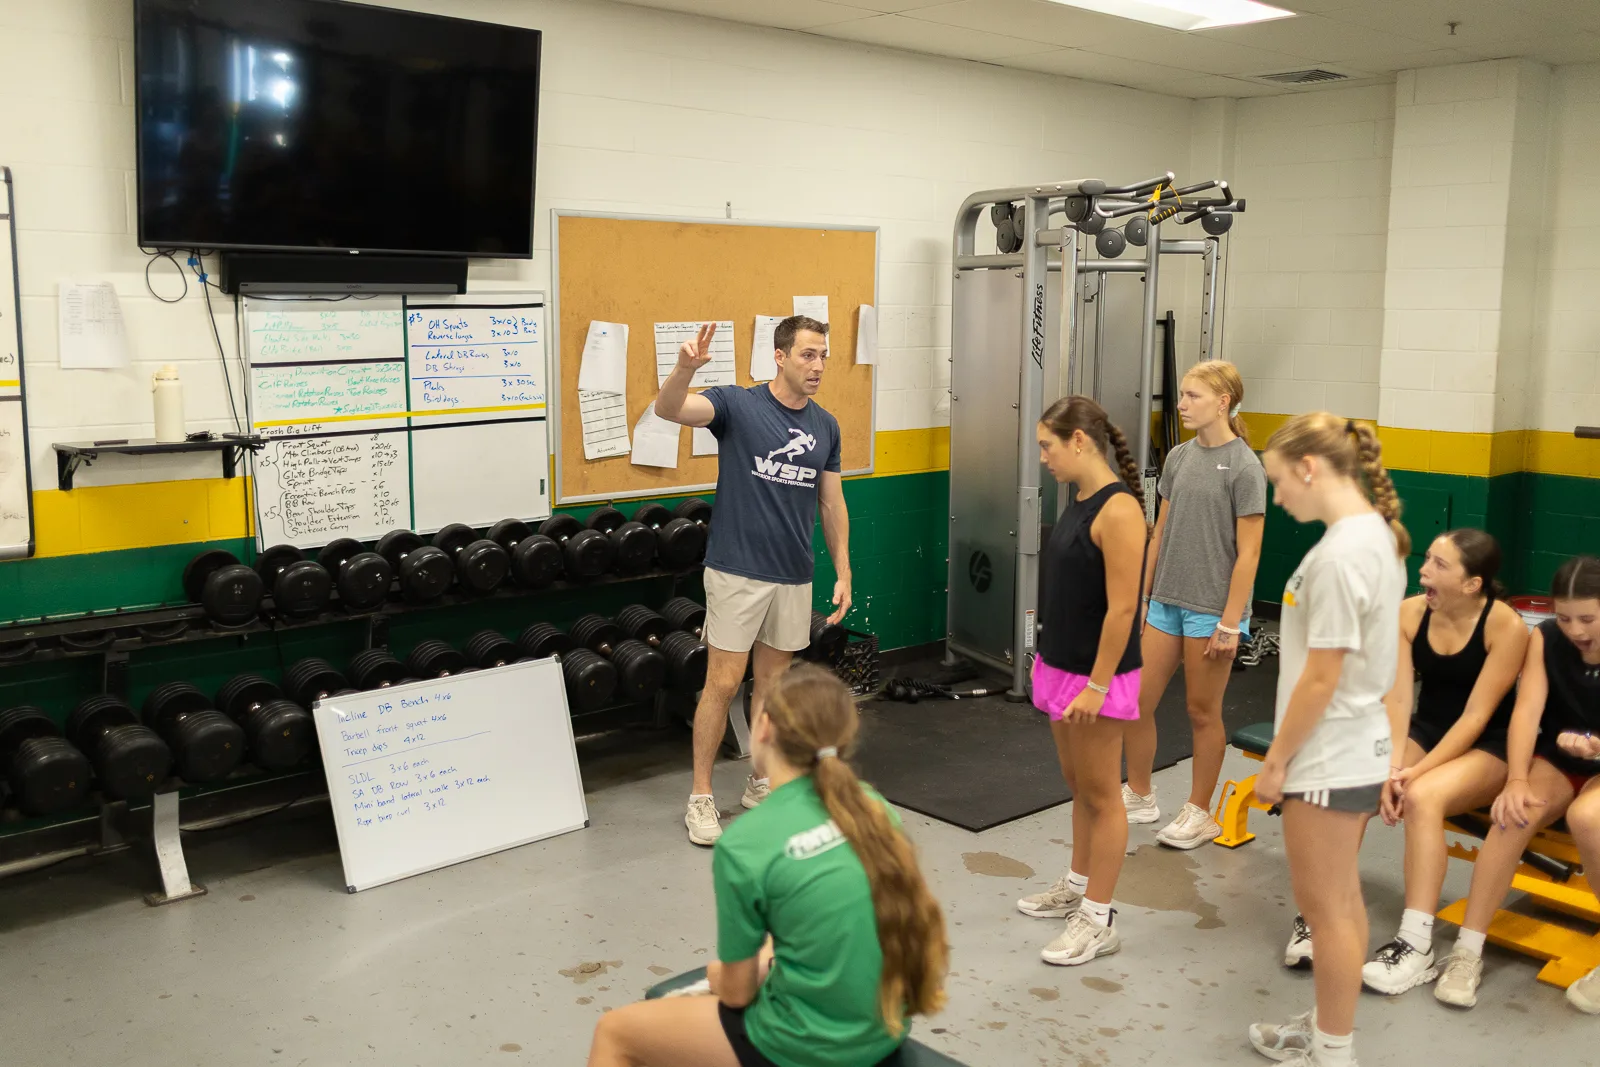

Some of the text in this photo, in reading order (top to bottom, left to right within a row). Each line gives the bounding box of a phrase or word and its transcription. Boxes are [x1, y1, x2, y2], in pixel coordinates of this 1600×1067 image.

[428, 331, 453, 341] Reverse
[425, 349, 455, 360] Lateral
[425, 363, 438, 372] DB
[284, 380, 308, 388] Raises
[259, 426, 284, 436] Frosh
[303, 424, 322, 433] Lift
[282, 442, 305, 450] Front
[306, 439, 331, 449] Squat
[300, 447, 332, 457] Climbers
[260, 456, 271, 468] x5
[283, 460, 302, 470] High
[283, 469, 306, 480] Glute
[308, 467, 332, 479] Bridge
[754, 455, 818, 482] WSP
[286, 479, 316, 490] Sprint
[284, 490, 317, 501] Eccentric
[319, 488, 341, 497] Bench
[341, 485, 357, 495] Press
[264, 506, 277, 519] x5
[308, 504, 339, 515] Shoulder
[287, 518, 324, 528] Shoulder
[328, 514, 361, 524] Extension
[291, 526, 327, 537] Suitcase
[337, 711, 368, 723] Incline
[378, 702, 393, 715] DB
[400, 696, 429, 709] Bench
[341, 729, 370, 742] Barbell
[376, 724, 398, 735] front
[405, 717, 428, 730] squat
[344, 746, 368, 757] Tricep
[372, 741, 388, 754] dips
[348, 772, 375, 785] SLDL
[412, 758, 430, 769] each
[352, 788, 365, 800] SA
[371, 784, 384, 795] DB
[439, 766, 457, 777] each
[354, 800, 374, 812] Mini
[377, 796, 395, 807] band
[401, 789, 423, 801] lateral
[476, 775, 490, 784] each
[356, 817, 373, 827] Rope
